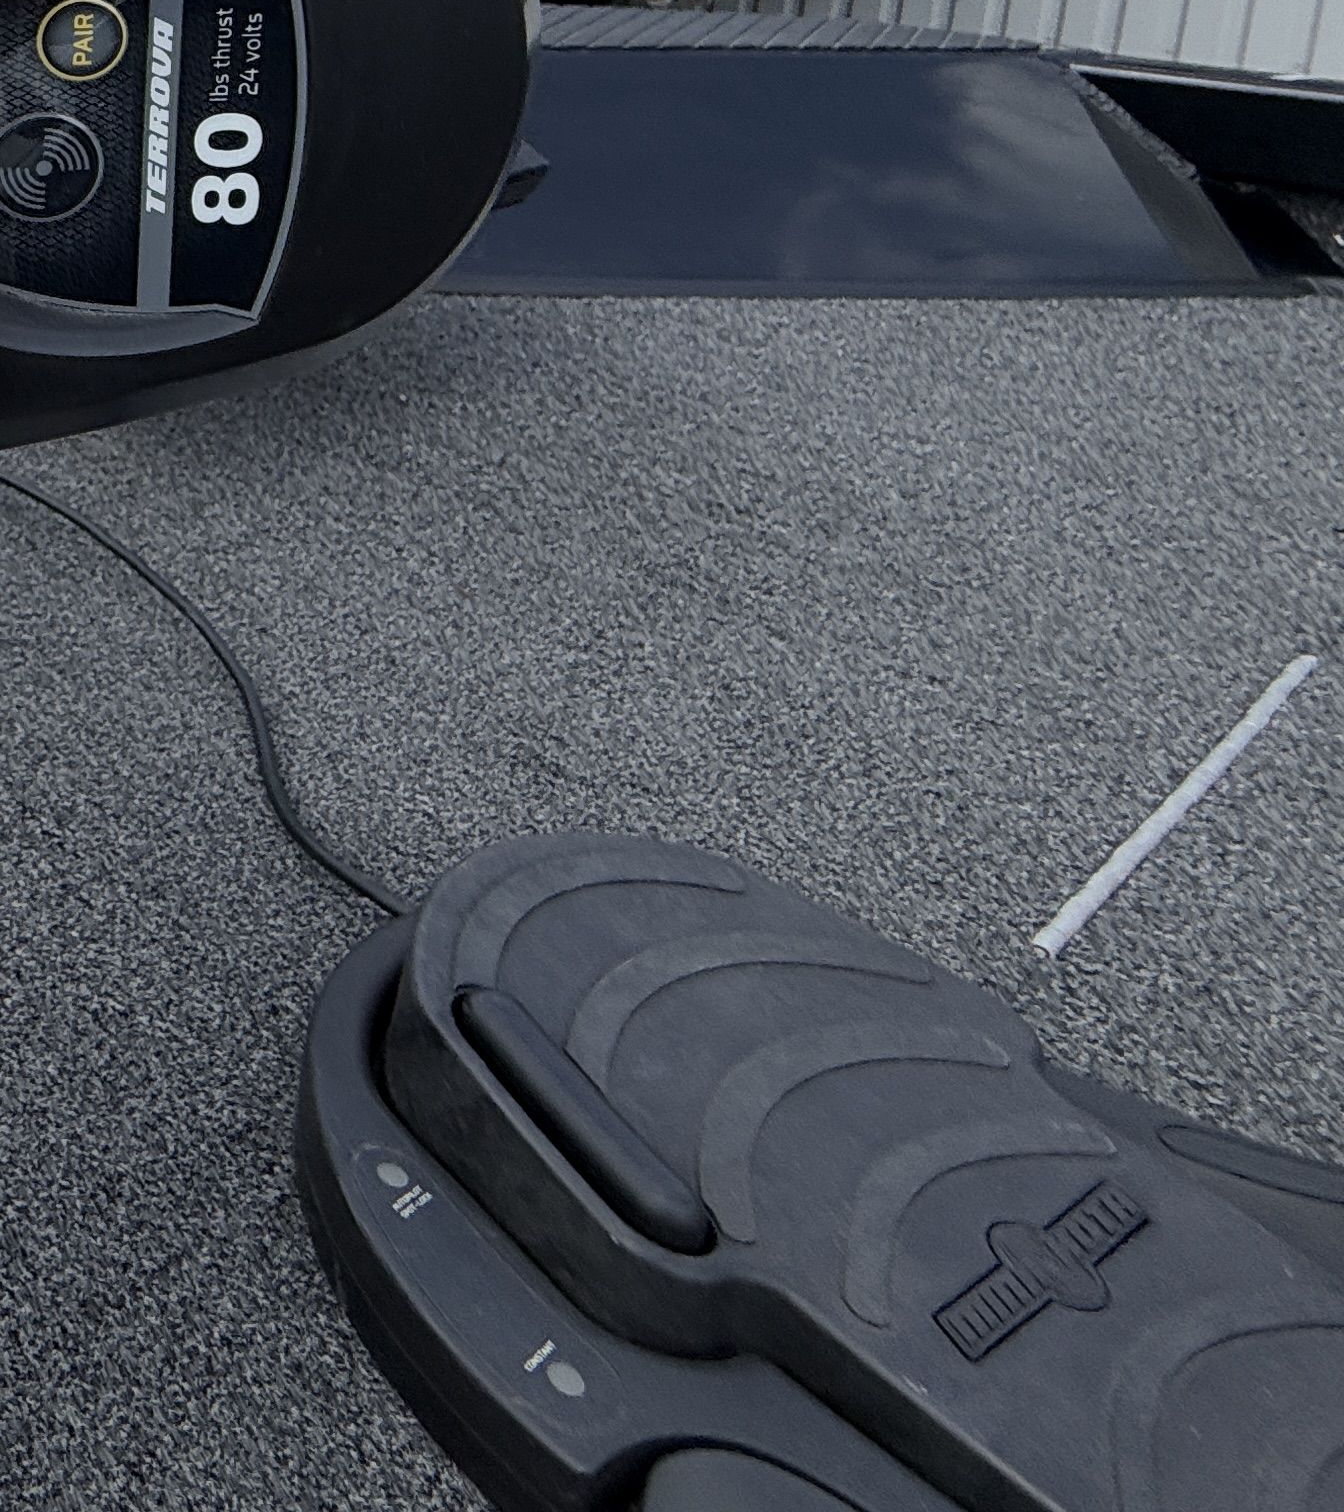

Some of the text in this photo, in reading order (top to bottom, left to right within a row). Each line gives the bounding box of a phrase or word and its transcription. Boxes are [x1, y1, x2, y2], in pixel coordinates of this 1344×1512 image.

[72, 12, 95, 67] PAIR
[209, 8, 234, 102] lbs thrust
[238, 12, 264, 96] 24 volts
[145, 16, 175, 217] TERROVA
[191, 112, 264, 226] 80
